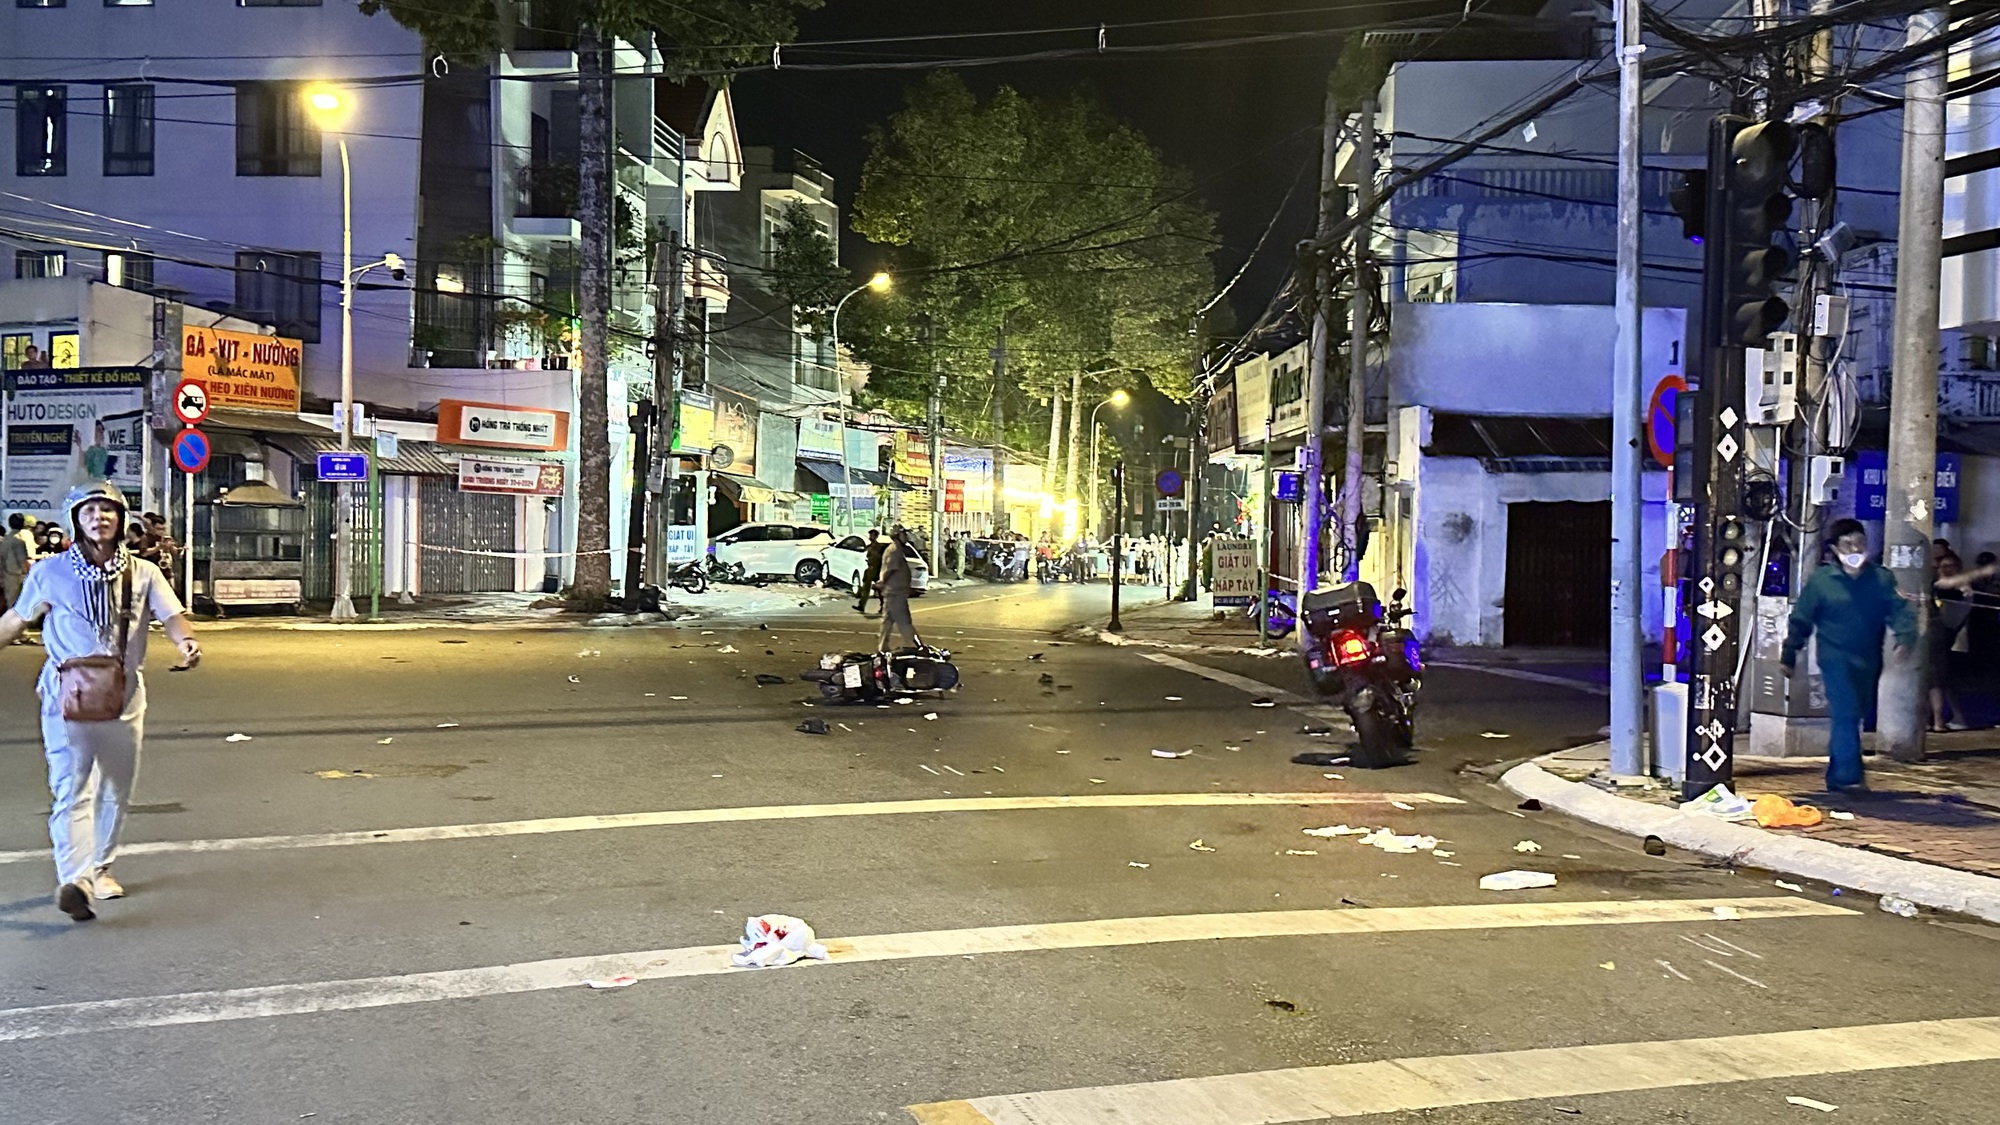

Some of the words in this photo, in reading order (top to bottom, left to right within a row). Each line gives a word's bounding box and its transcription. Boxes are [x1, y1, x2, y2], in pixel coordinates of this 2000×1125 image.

[47, 402, 96, 419] DESIGN
[108, 428, 126, 444] WE
[1863, 469, 1880, 485] KHU
[1870, 495, 1885, 508] SEA
[1217, 543, 1252, 551] LAUNDRY
